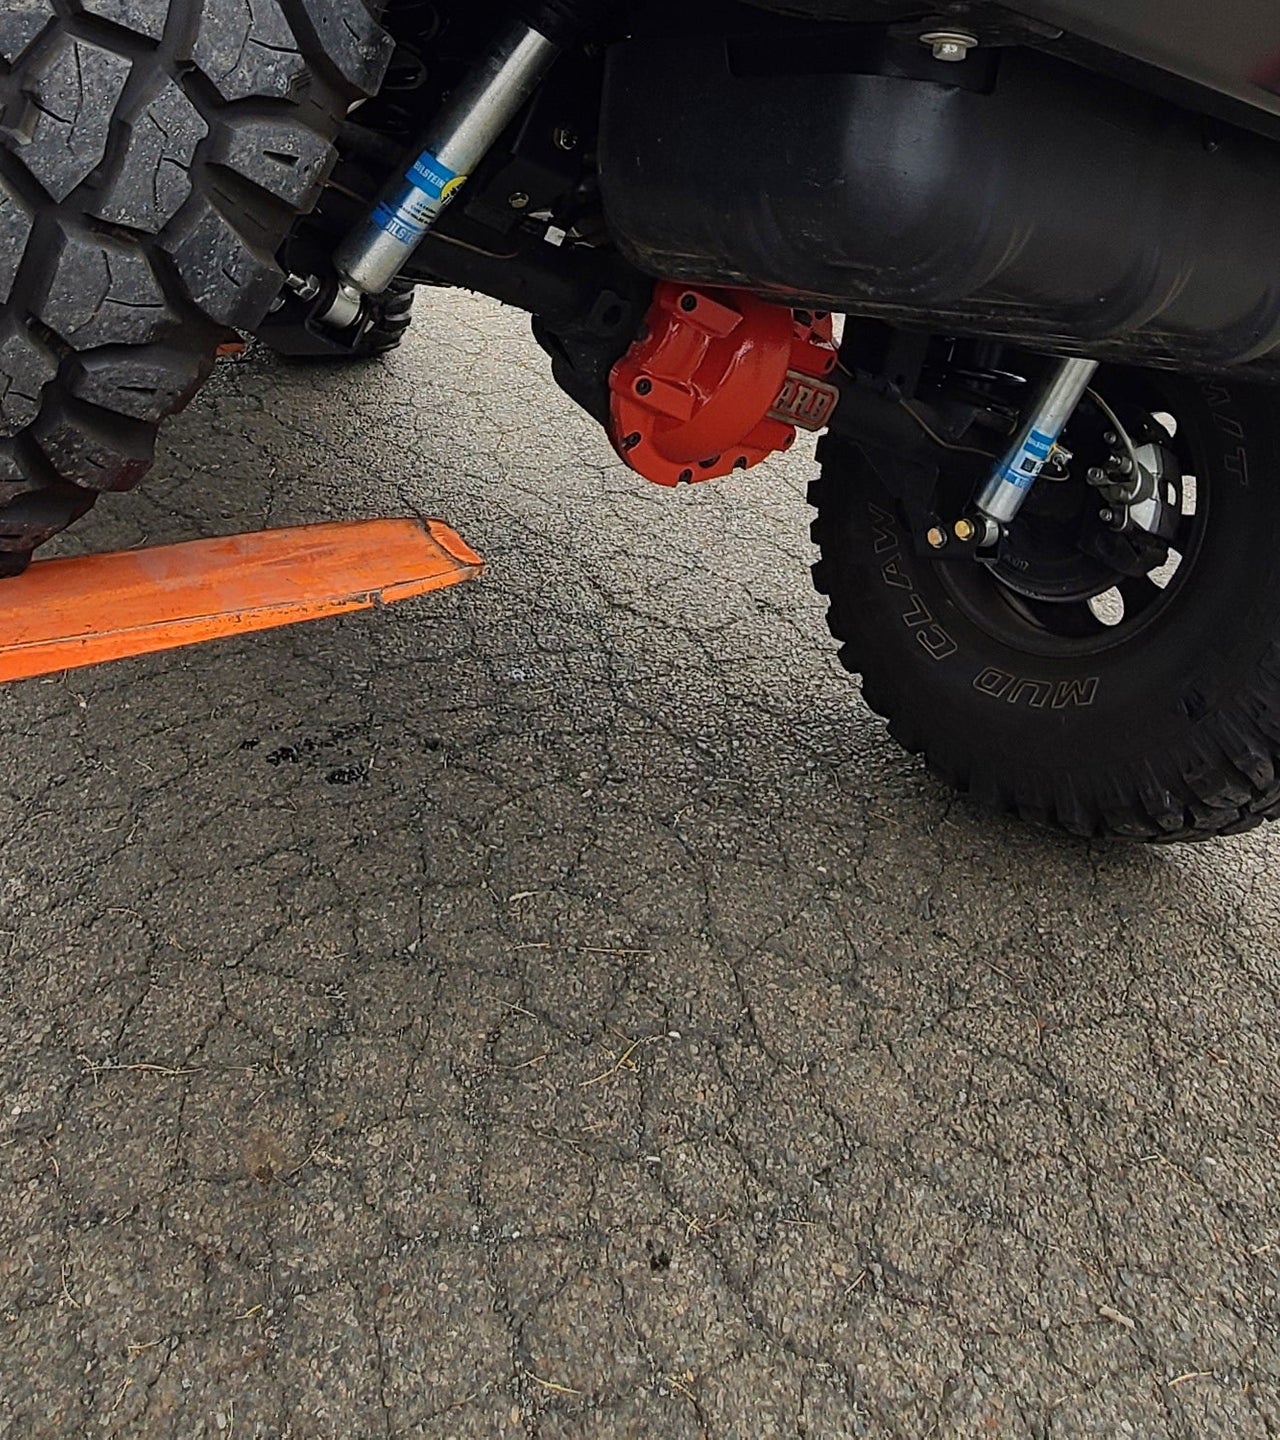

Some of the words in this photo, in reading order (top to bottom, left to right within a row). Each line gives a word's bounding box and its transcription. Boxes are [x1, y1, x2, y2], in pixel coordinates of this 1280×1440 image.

[413, 161, 447, 189] BILSTEIN
[772, 381, 829, 418] ARB
[868, 502, 958, 660] CLAW
[972, 665, 1100, 709] MUD
